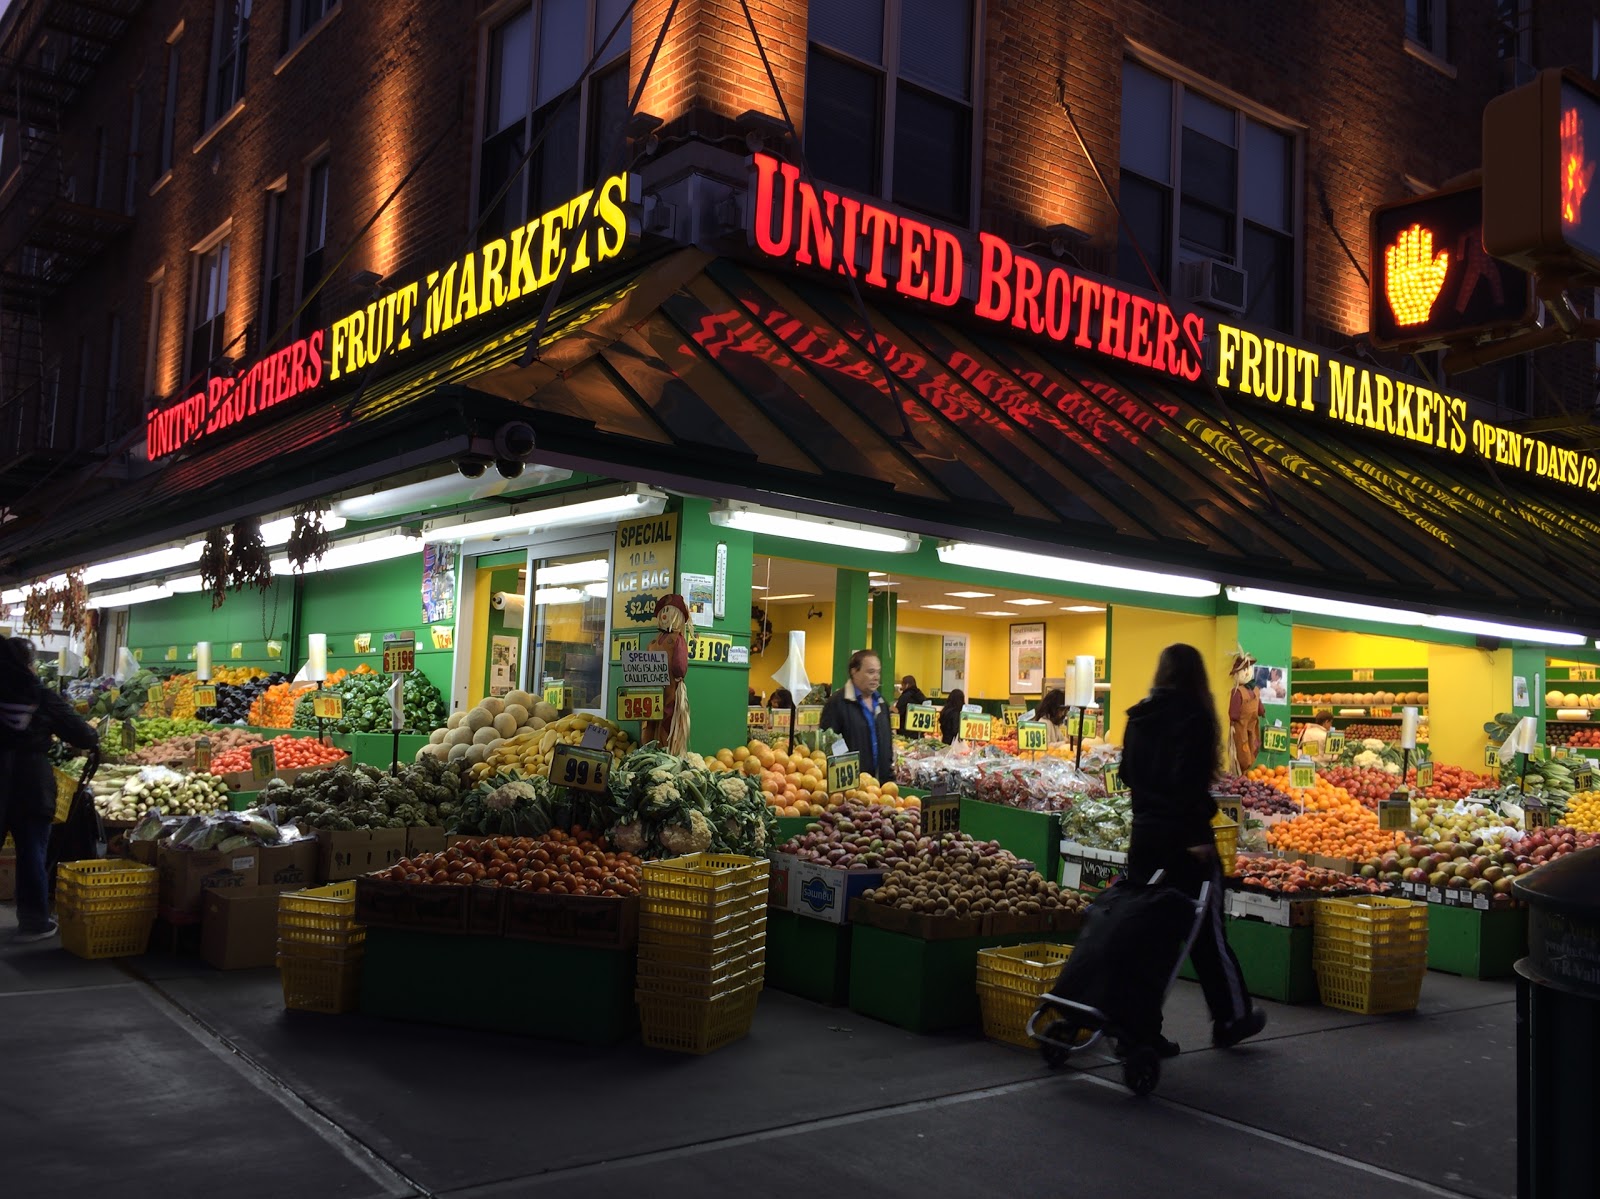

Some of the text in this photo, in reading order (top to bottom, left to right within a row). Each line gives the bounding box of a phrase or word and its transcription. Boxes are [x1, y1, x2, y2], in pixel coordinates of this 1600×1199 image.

[754, 152, 1204, 382] UNITED BROTHERS
[147, 171, 629, 461] UNITED BROTHERS FRUIT MARKETS
[1217, 323, 1600, 492] FRUIT MARKETS OPEN 7 DAYS/2
[621, 520, 672, 548] SPECIAL
[630, 552, 641, 566] 10
[617, 567, 670, 593] ICE BAG
[630, 600, 656, 616] $2.49
[384, 652, 390, 671] 6
[397, 650, 413, 671] 199
[688, 640, 697, 659] 3
[708, 641, 731, 662] 199
[623, 663, 668, 673] LONG ISLAND
[624, 673, 670, 683] CAULIFLOWER
[624, 695, 660, 719] 349 EA
[1025, 730, 1042, 748] 199
[564, 758, 589, 785] 99
[836, 763, 854, 789] 149
[939, 808, 960, 832] 199
